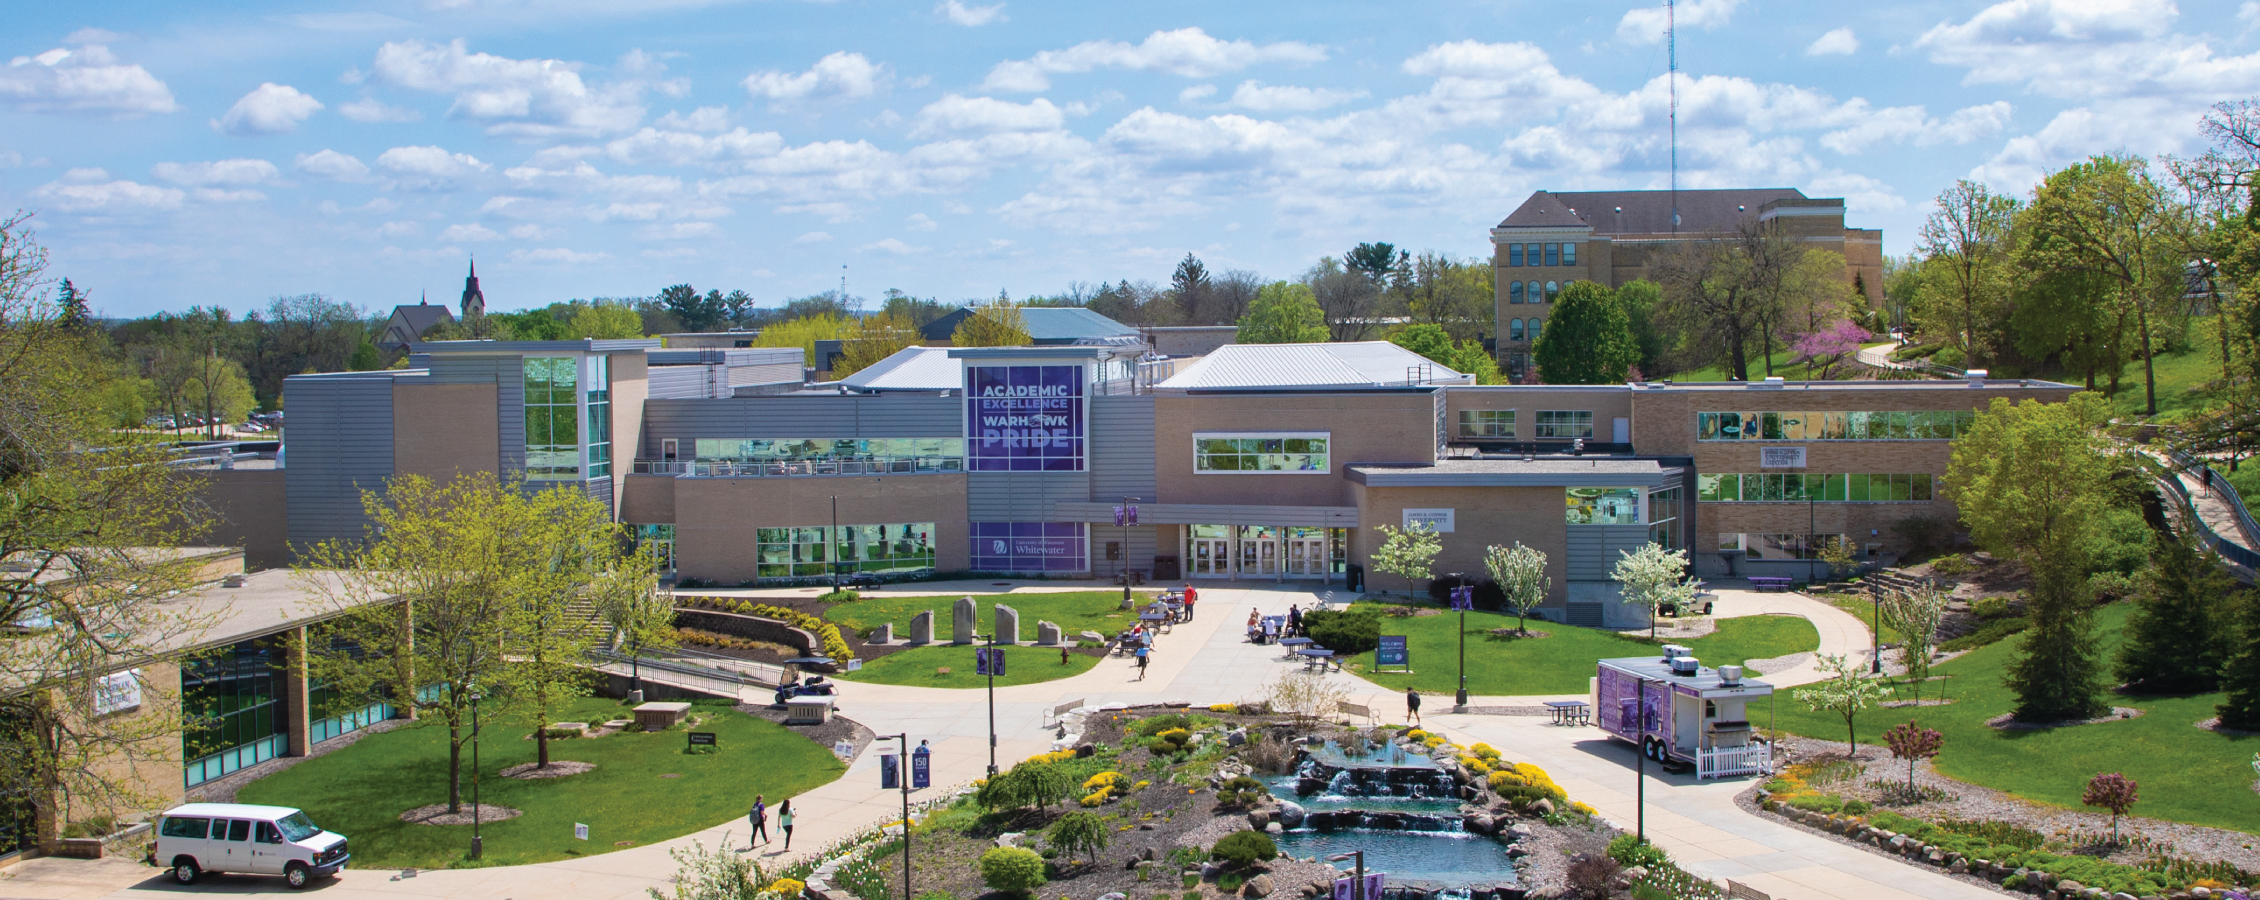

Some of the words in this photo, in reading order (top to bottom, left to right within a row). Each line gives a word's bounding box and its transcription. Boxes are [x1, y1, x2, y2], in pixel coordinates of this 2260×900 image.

[983, 385, 1068, 397] ACADEMIC
[983, 399, 1068, 409] EXCELLENCE
[983, 429, 1069, 448] PRIDE
[1016, 546, 1065, 554] Whitewater
[915, 758, 926, 766] 150
